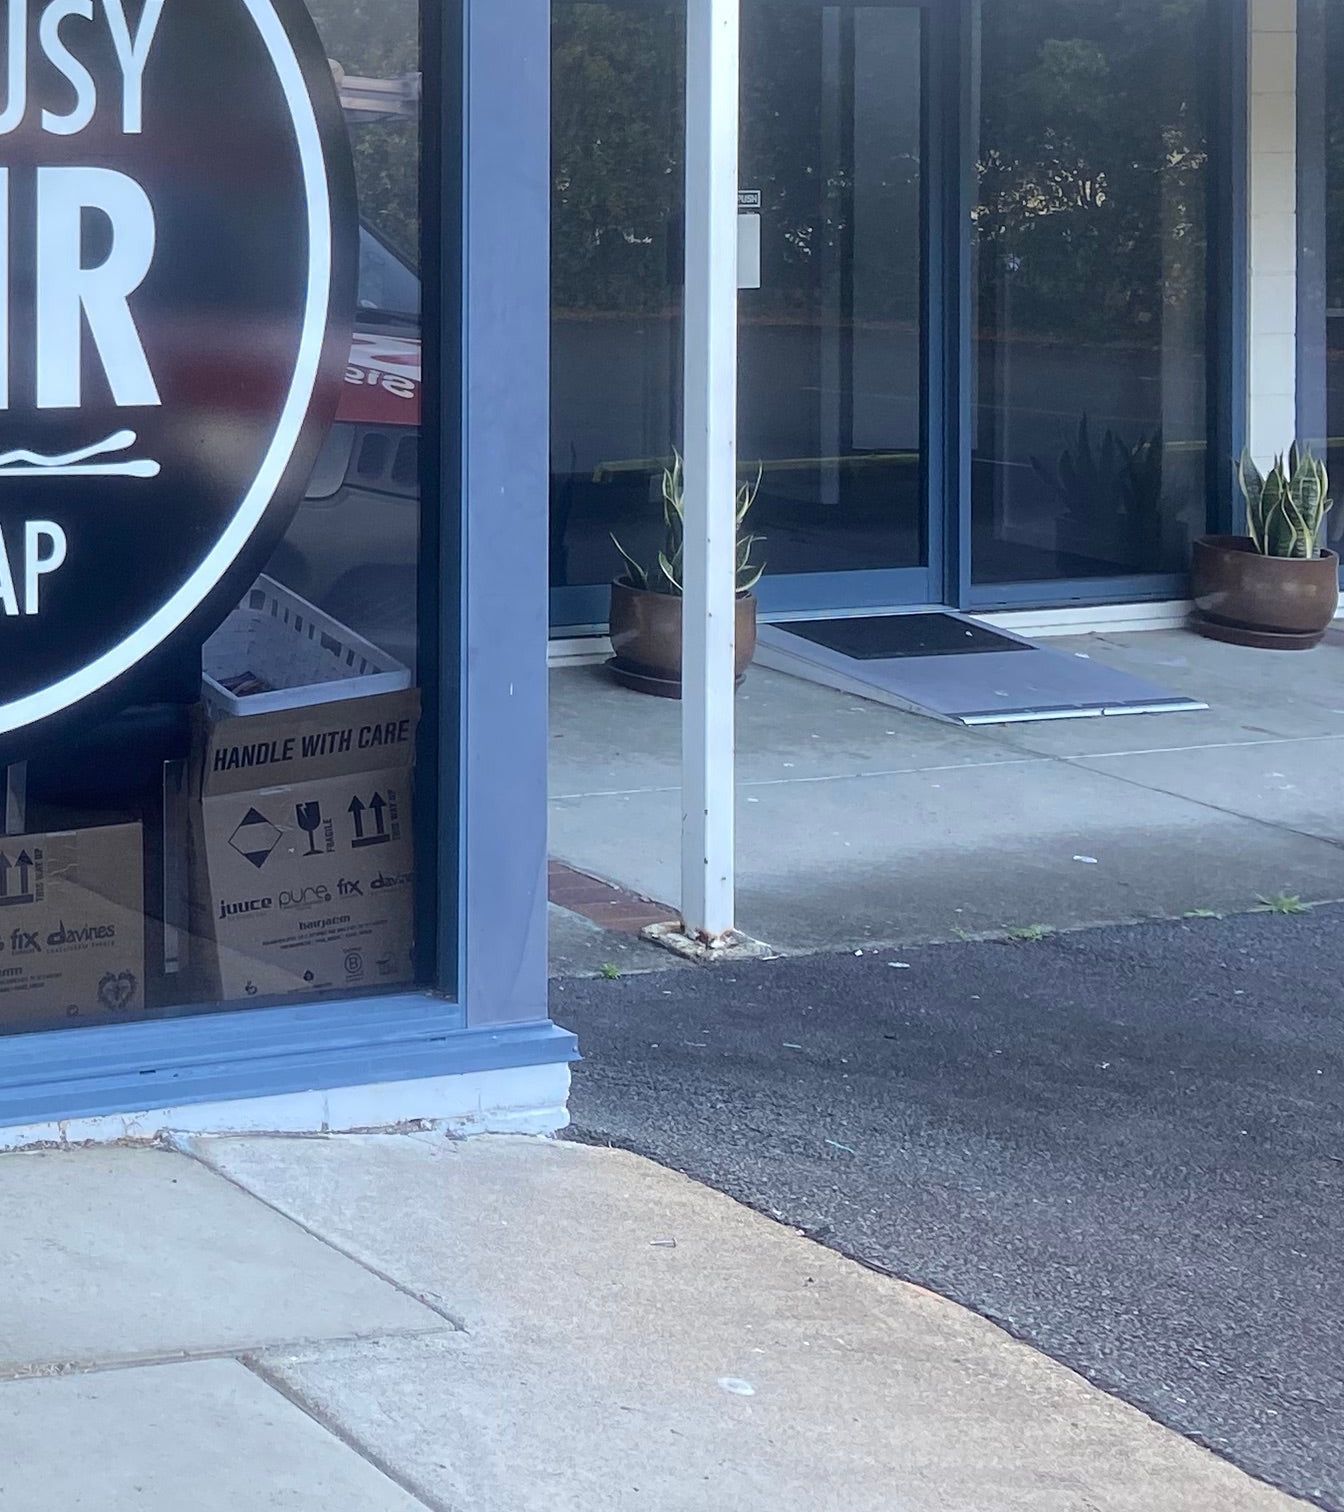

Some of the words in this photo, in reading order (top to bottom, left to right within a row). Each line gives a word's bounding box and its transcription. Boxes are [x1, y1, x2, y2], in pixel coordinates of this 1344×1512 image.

[213, 737, 295, 772] HANDLE
[301, 728, 354, 760] WITH
[357, 719, 411, 750] CARE
[322, 818, 336, 853] FRAGILE
[219, 897, 273, 919] juuce
[278, 884, 327, 910] pure
[337, 879, 363, 896] fix
[11, 929, 41, 953] fix
[46, 920, 115, 947] davines
